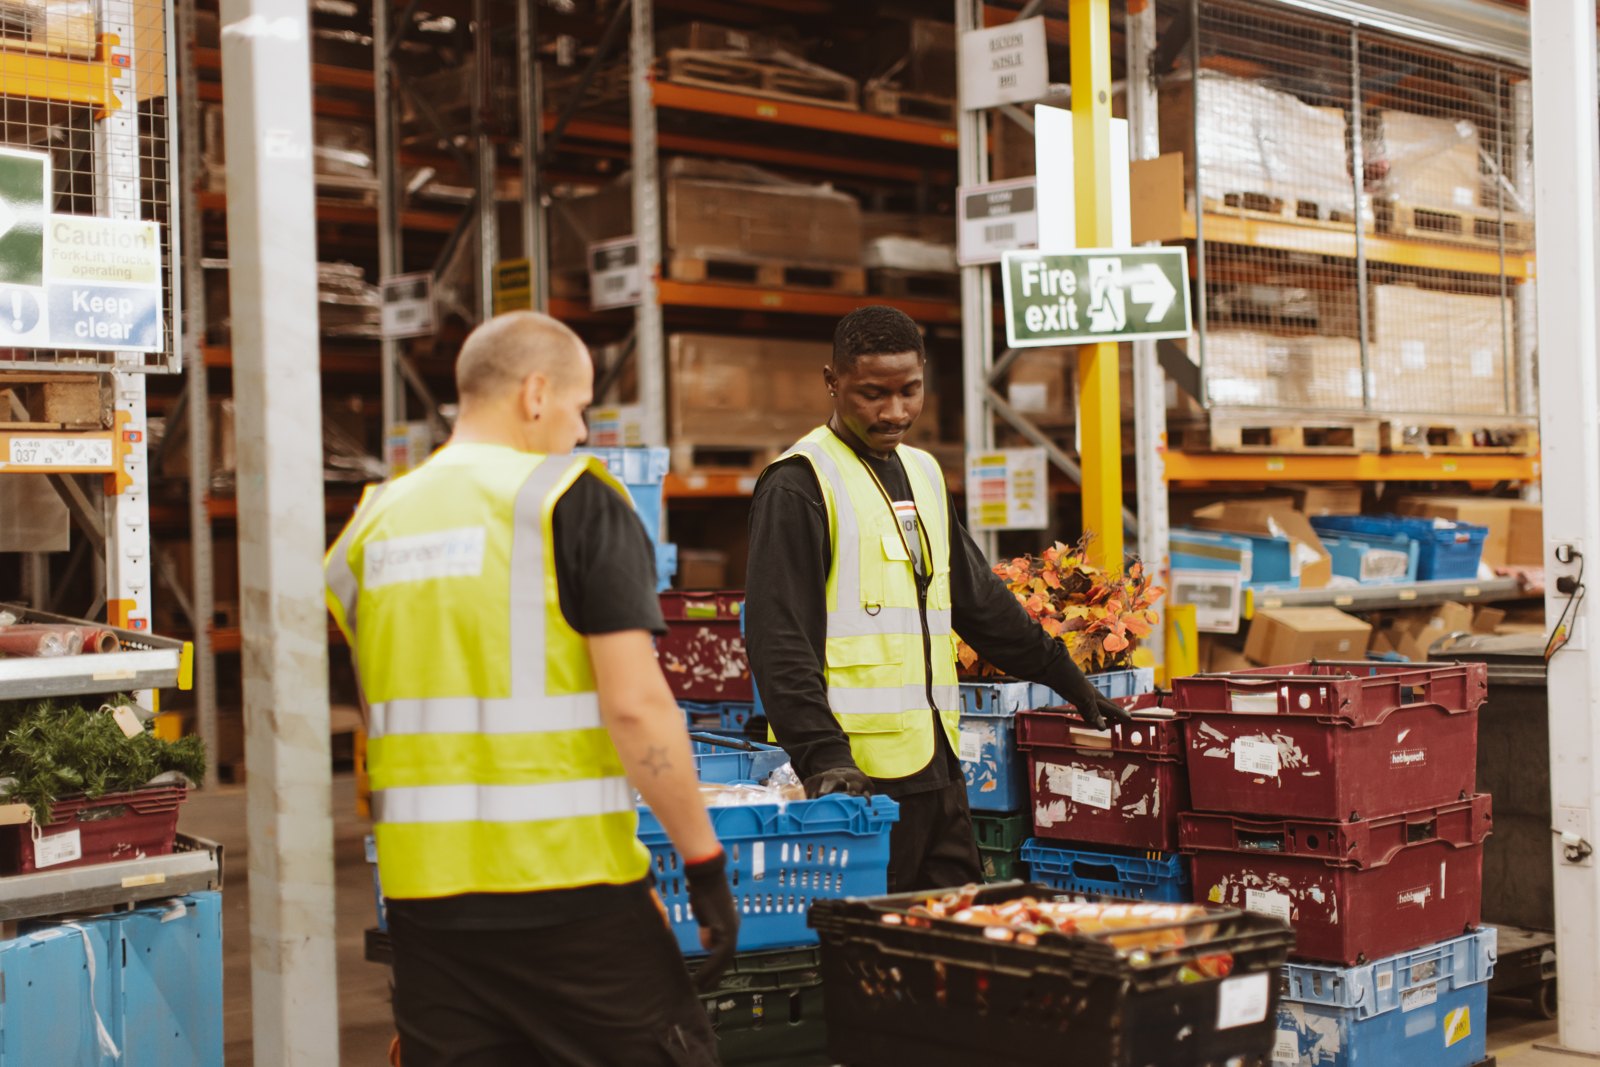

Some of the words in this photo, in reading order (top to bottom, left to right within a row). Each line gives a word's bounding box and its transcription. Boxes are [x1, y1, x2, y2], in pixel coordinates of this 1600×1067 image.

[53, 223, 148, 250] Caution
[52, 249, 106, 264] Fork-Lift
[111, 251, 151, 266] Trucks
[72, 264, 133, 280] operating
[1020, 262, 1077, 298] Fire
[72, 290, 133, 317] Keep
[1025, 297, 1080, 333] exit
[74, 316, 134, 340] clear
[15, 449, 37, 463] 037
